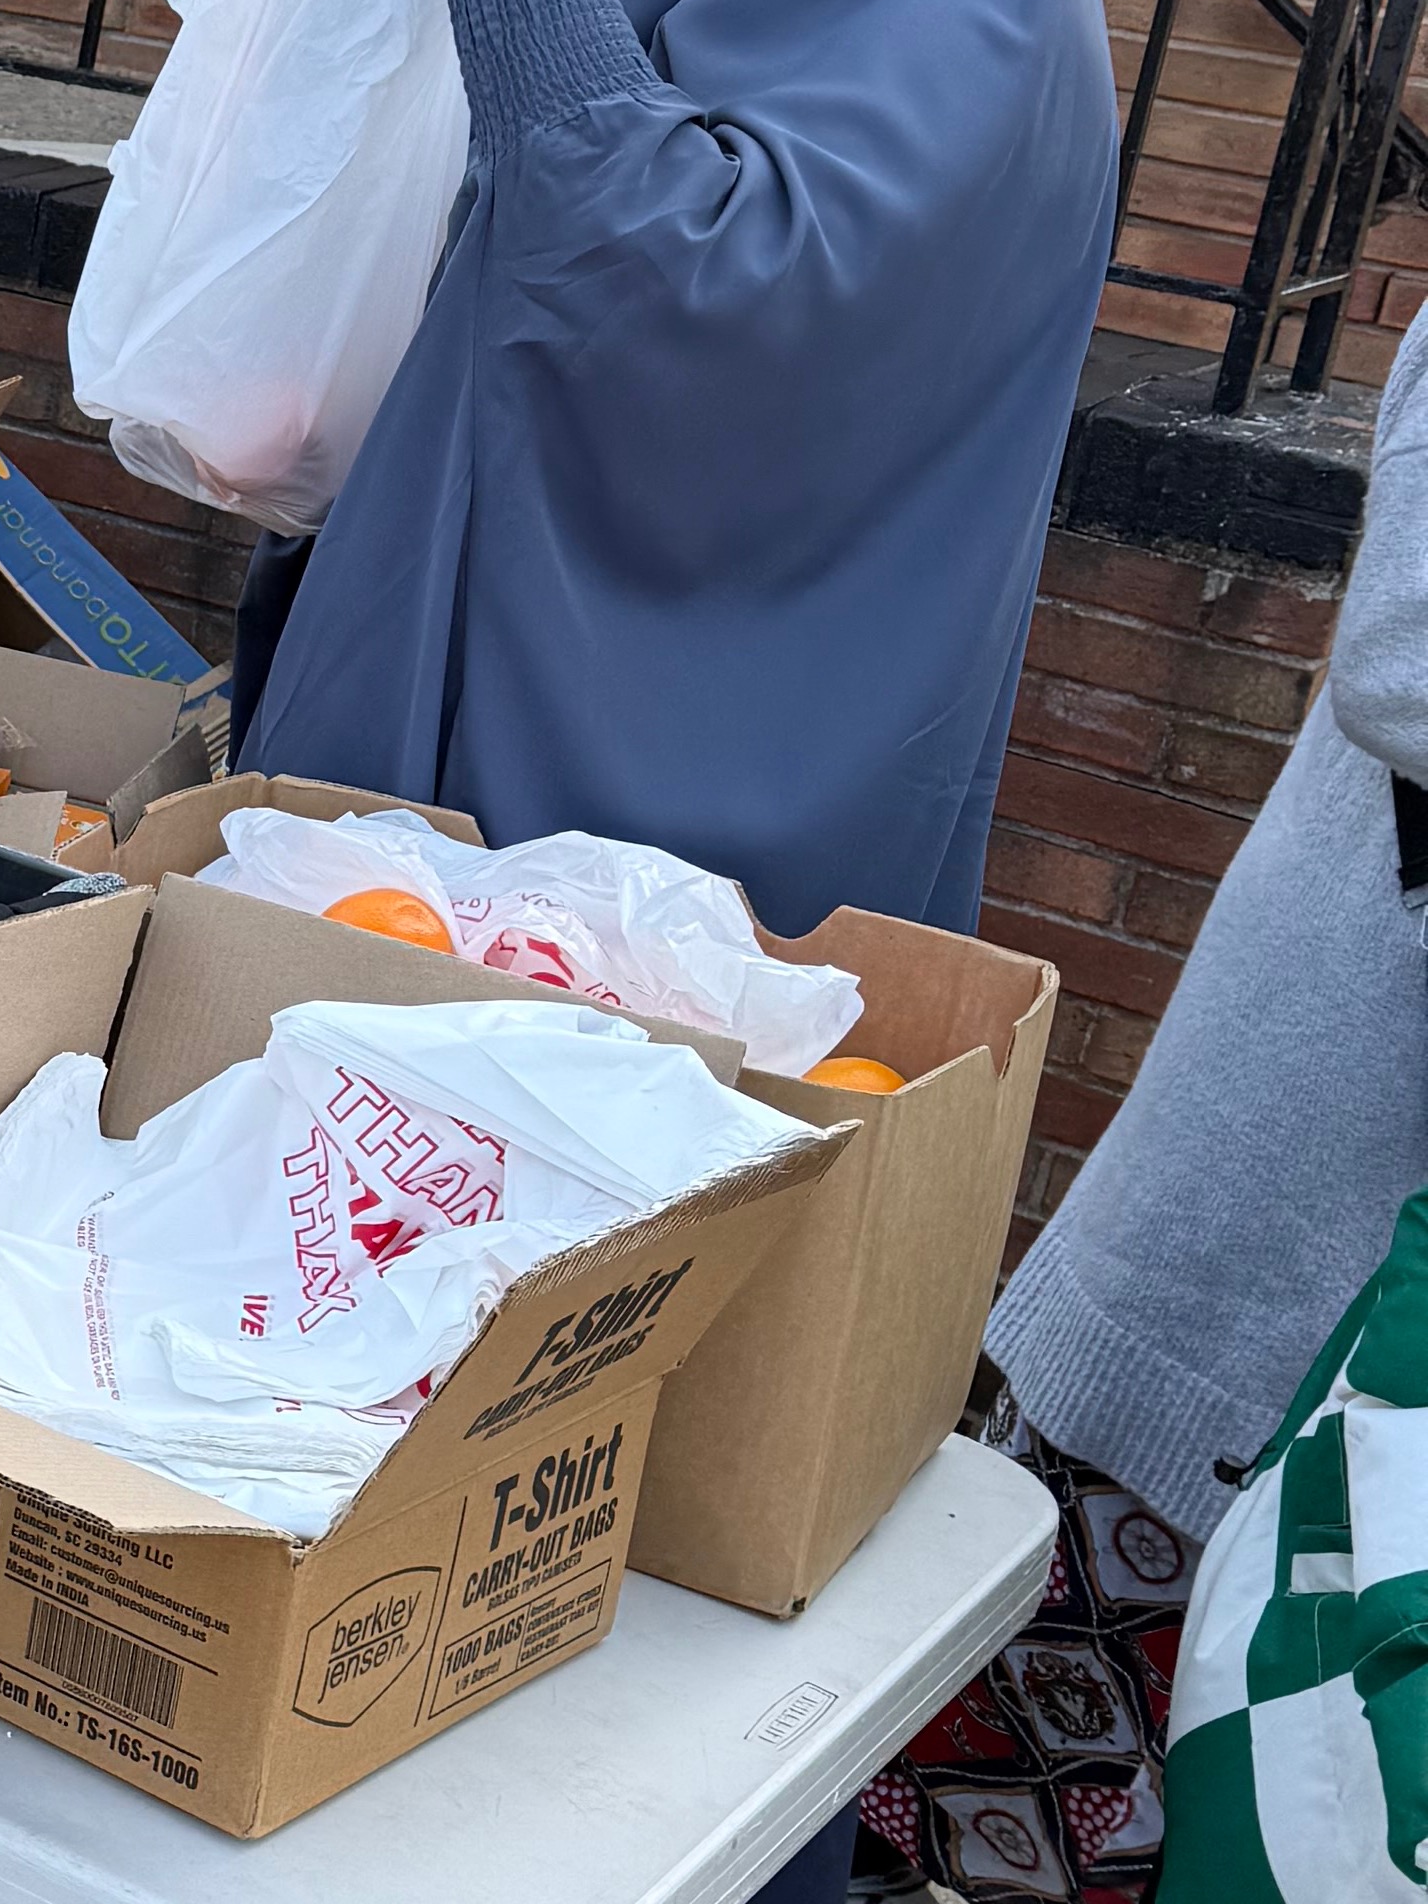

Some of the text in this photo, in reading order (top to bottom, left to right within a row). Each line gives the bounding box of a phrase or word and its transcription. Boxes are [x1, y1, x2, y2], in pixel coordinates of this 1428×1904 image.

[489, 1422, 624, 1553] T-Shirt
[11, 1523, 48, 1552] Email:
[14, 1506, 123, 1568] Duncan, SC 29334
[145, 1545, 174, 1571] LLC
[462, 1496, 619, 1609] CARRY-OUT BAGS
[5, 1558, 39, 1583] Made
[56, 1582, 90, 1608] INDIA
[8, 1540, 55, 1574] Website
[65, 1569, 208, 1644] www.uniquesourcing.us
[329, 1590, 423, 1656] berkley
[445, 1613, 526, 1679] 1000 BAGS
[317, 1633, 405, 1705] jensen
[34, 1692, 71, 1728] No.:
[76, 1709, 200, 1790] TS-16S-1000
